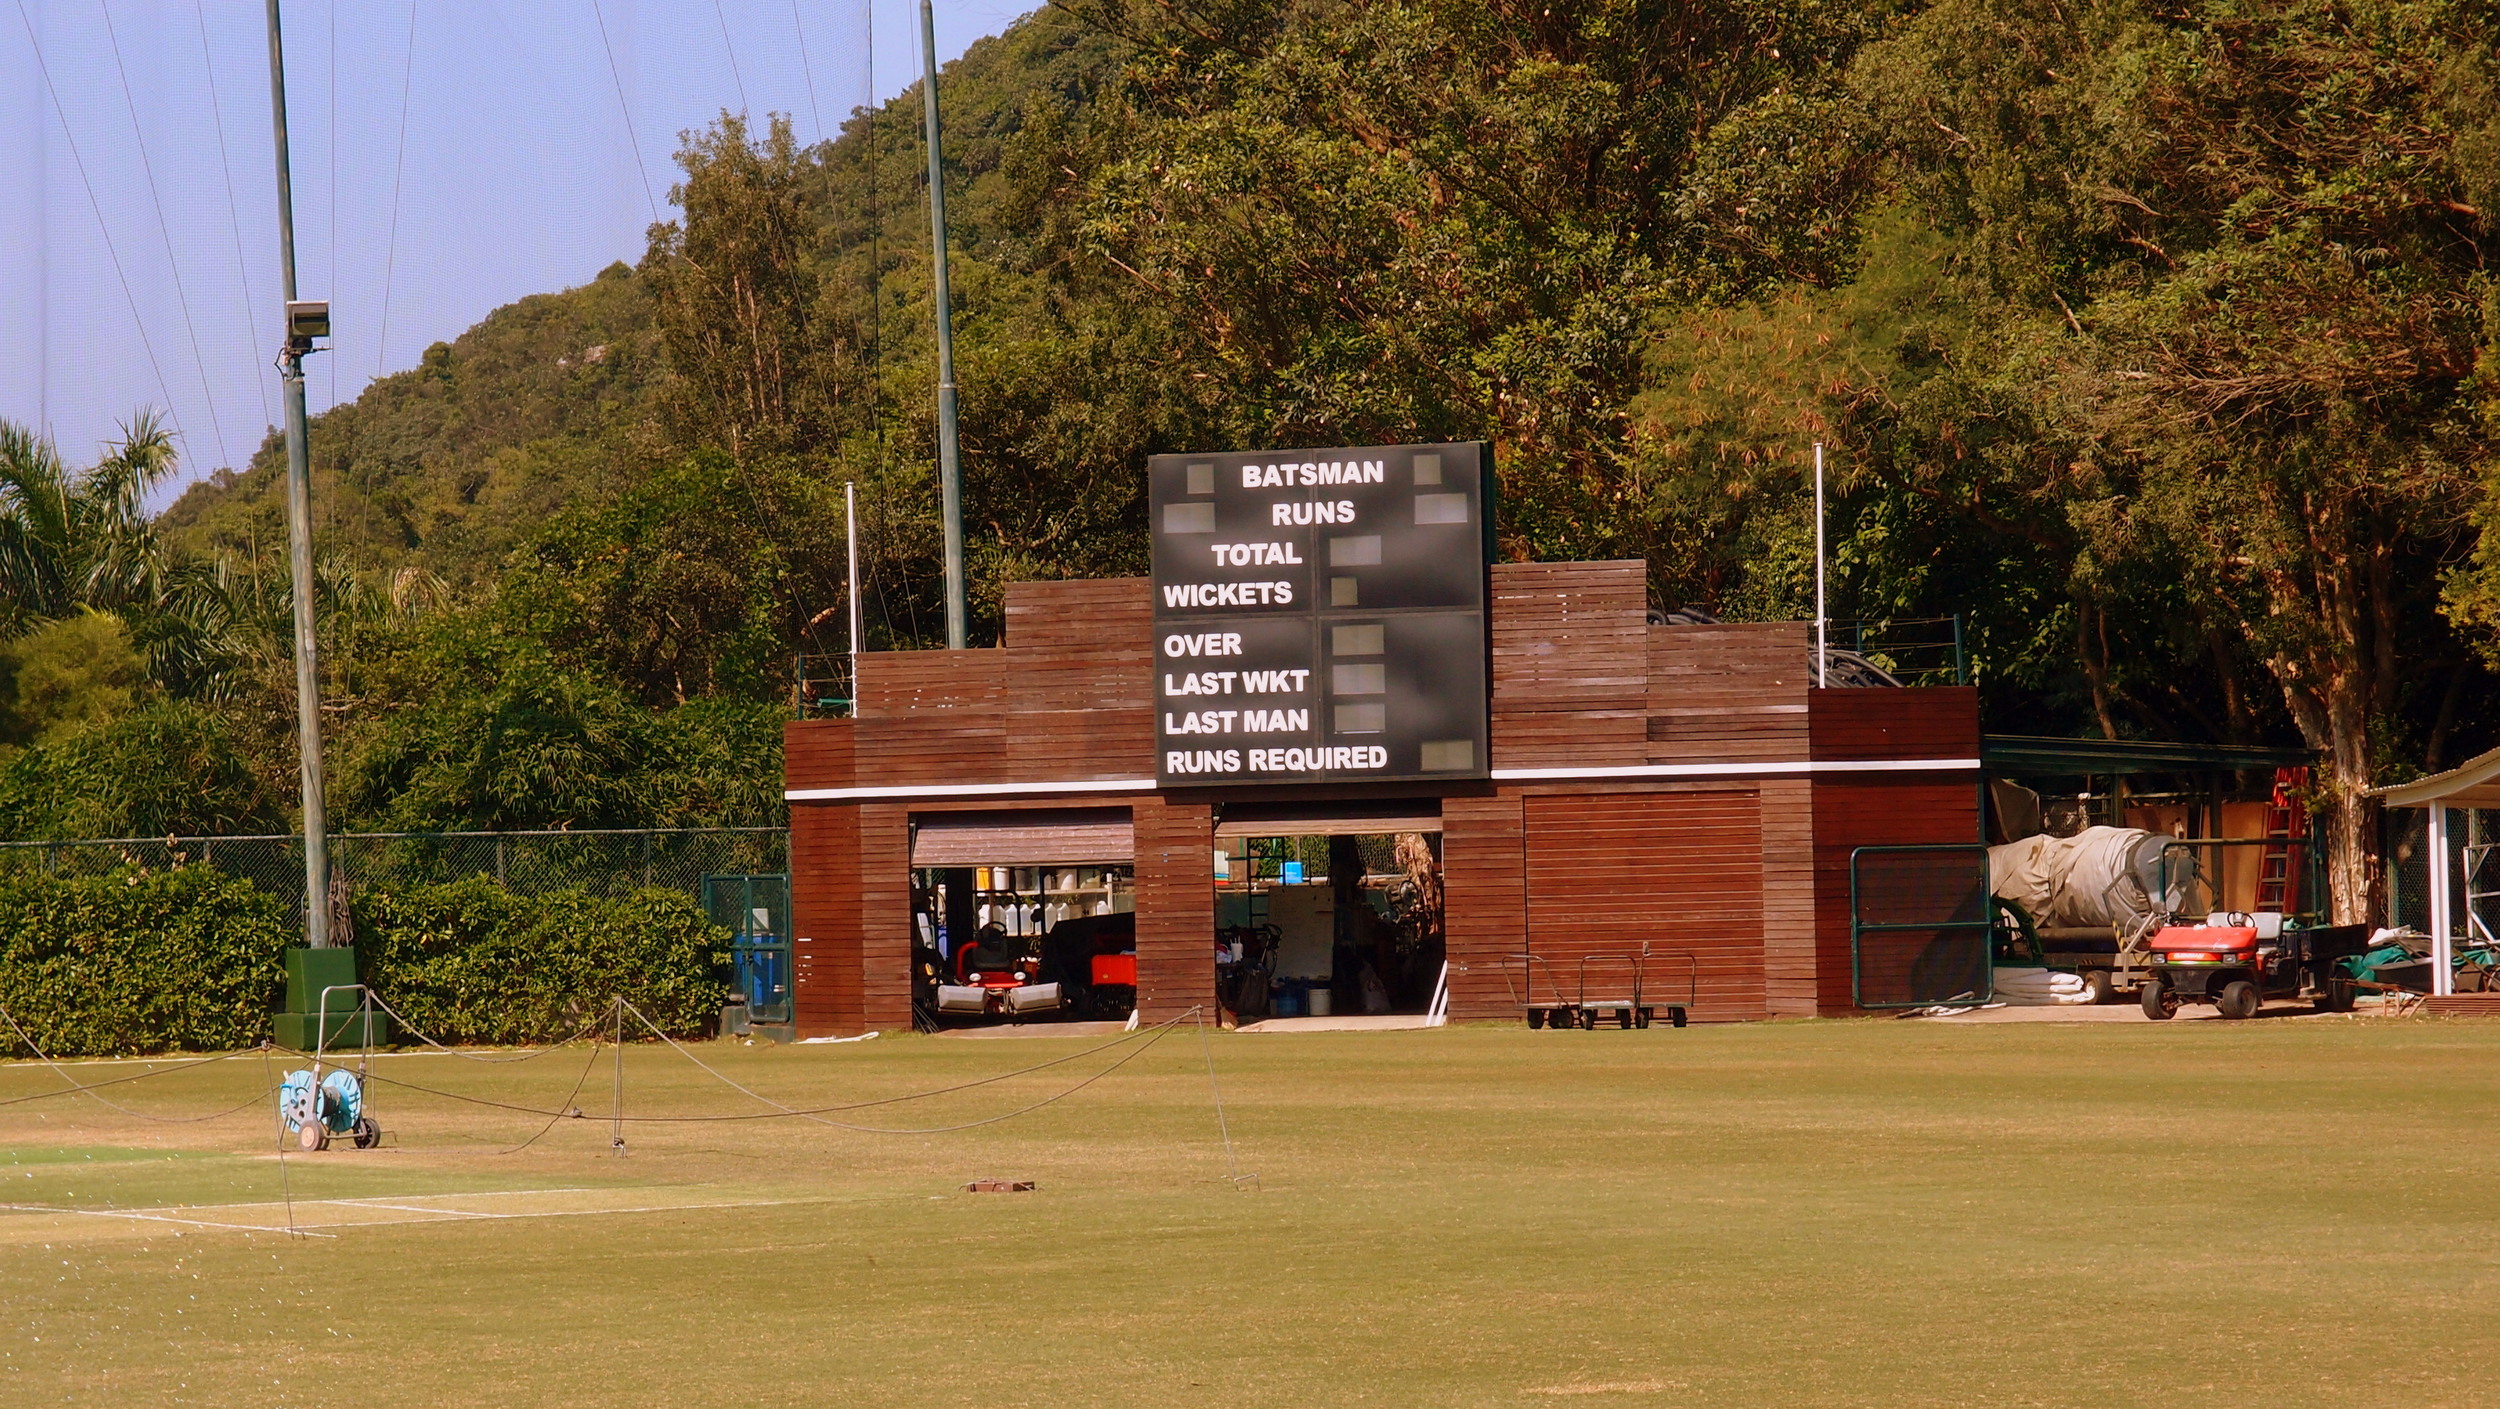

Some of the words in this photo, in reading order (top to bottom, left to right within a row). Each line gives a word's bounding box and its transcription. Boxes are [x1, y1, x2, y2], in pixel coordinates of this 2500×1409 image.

[1242, 461, 1384, 488] BATSMAN
[1272, 501, 1356, 526] RUNS
[1211, 542, 1303, 567] TOTAL
[1163, 581, 1293, 608] WICKETS
[1164, 632, 1243, 658] OVER
[1165, 672, 1237, 696] LAST
[1242, 669, 1310, 694] WKT
[1165, 711, 1237, 735] LAST
[1243, 708, 1309, 733] MAN
[1166, 750, 1241, 774] RUNS
[1248, 745, 1388, 772] REQUIRED
